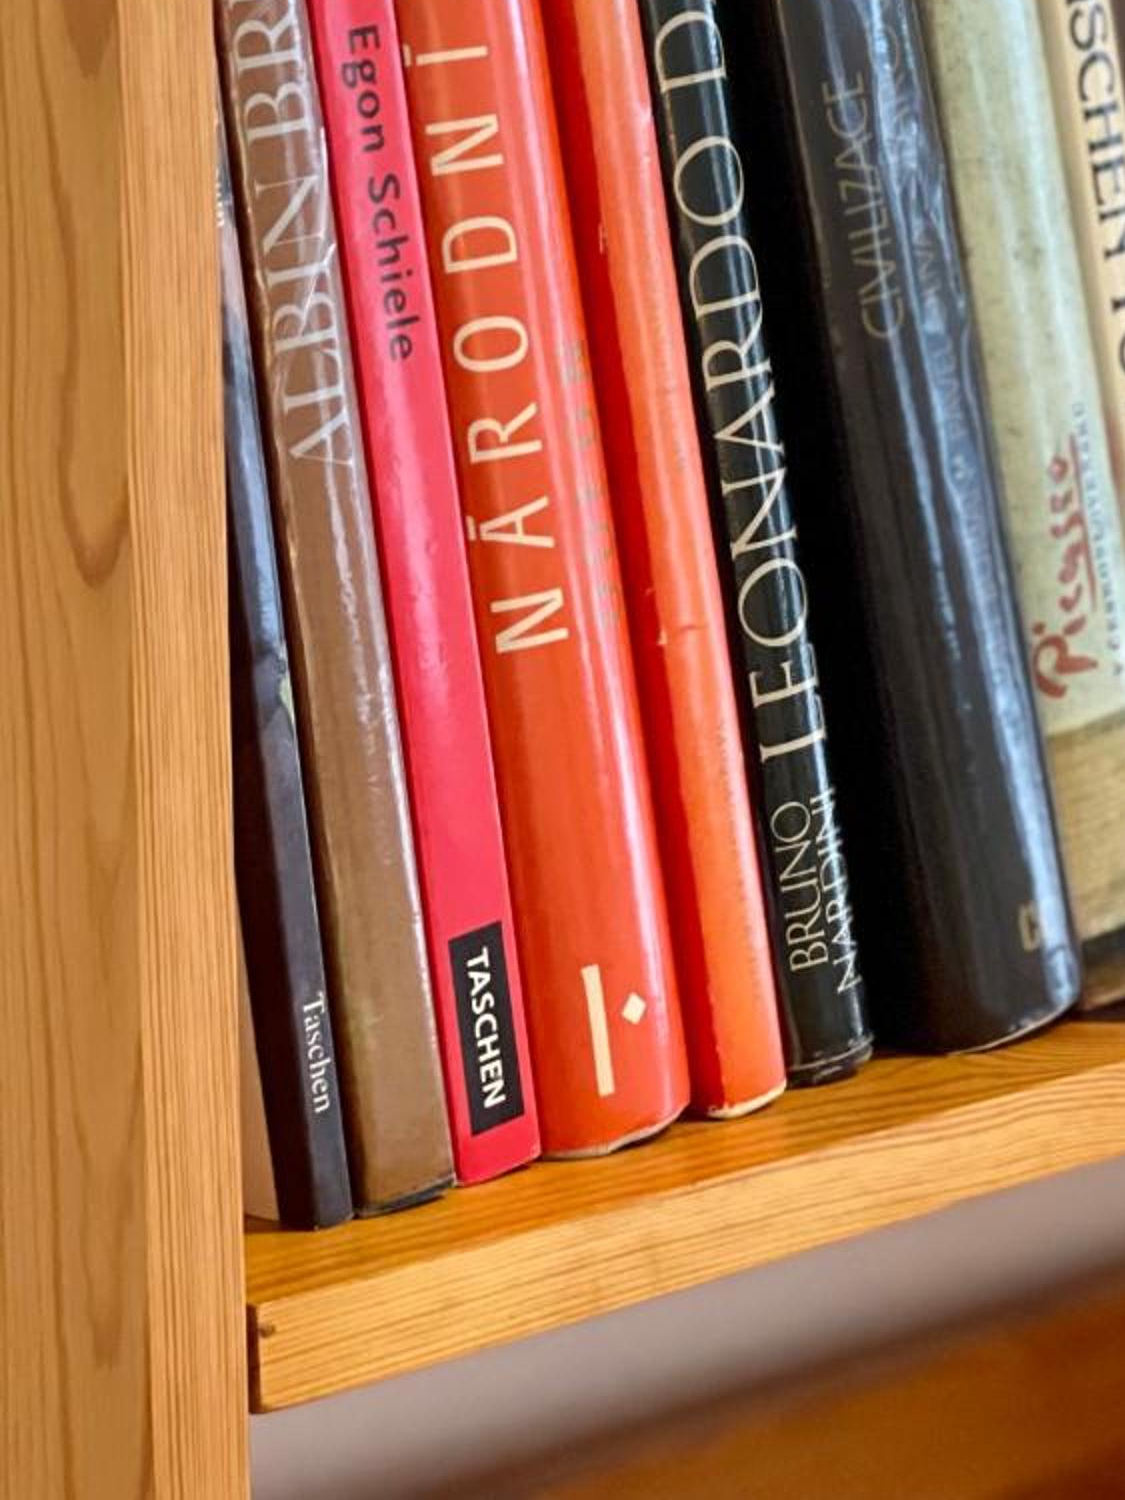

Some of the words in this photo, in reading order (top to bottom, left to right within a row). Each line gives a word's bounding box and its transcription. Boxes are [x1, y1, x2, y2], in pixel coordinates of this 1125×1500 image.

[254, 172, 356, 468] ALBIN
[340, 24, 387, 154] Egon
[367, 172, 422, 362] Schiele
[823, 69, 905, 341] CIVILIZACE
[673, 134, 828, 763] LEONARDO
[1034, 434, 1099, 699] Picasso
[771, 799, 830, 973] BRUNO
[300, 989, 332, 1116] Taschen
[464, 945, 507, 1110] TASCHEN
